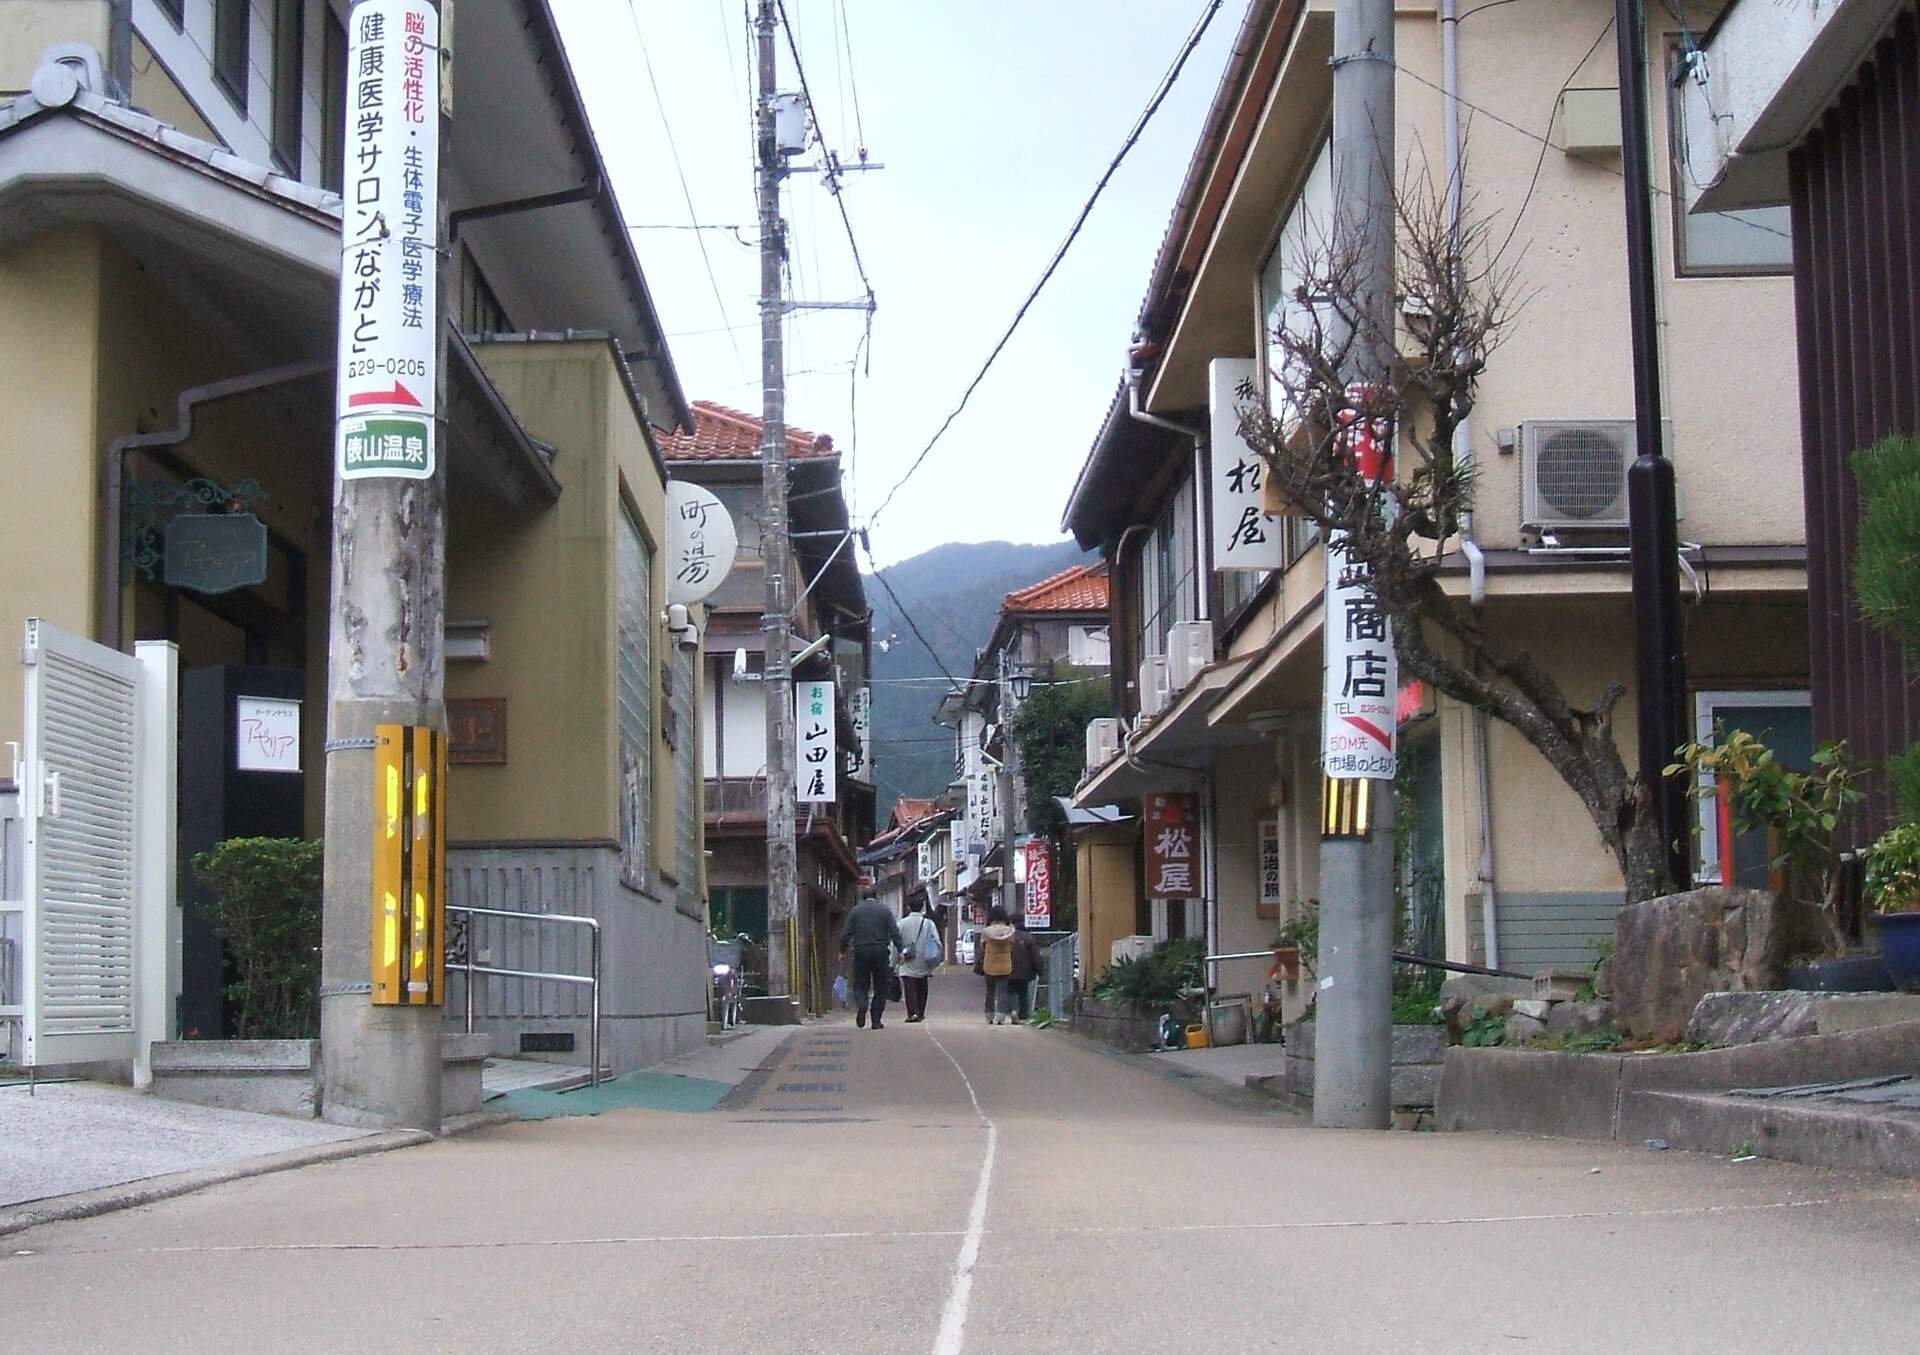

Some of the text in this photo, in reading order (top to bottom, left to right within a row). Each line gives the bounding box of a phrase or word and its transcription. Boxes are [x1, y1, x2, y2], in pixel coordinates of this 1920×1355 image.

[677, 501, 718, 584] 町の湯
[805, 686, 828, 796] お宿 山田屋
[1334, 702, 1355, 714] TEL
[1330, 736, 1368, 751] 50M先
[1154, 827, 1192, 893] 松屋
